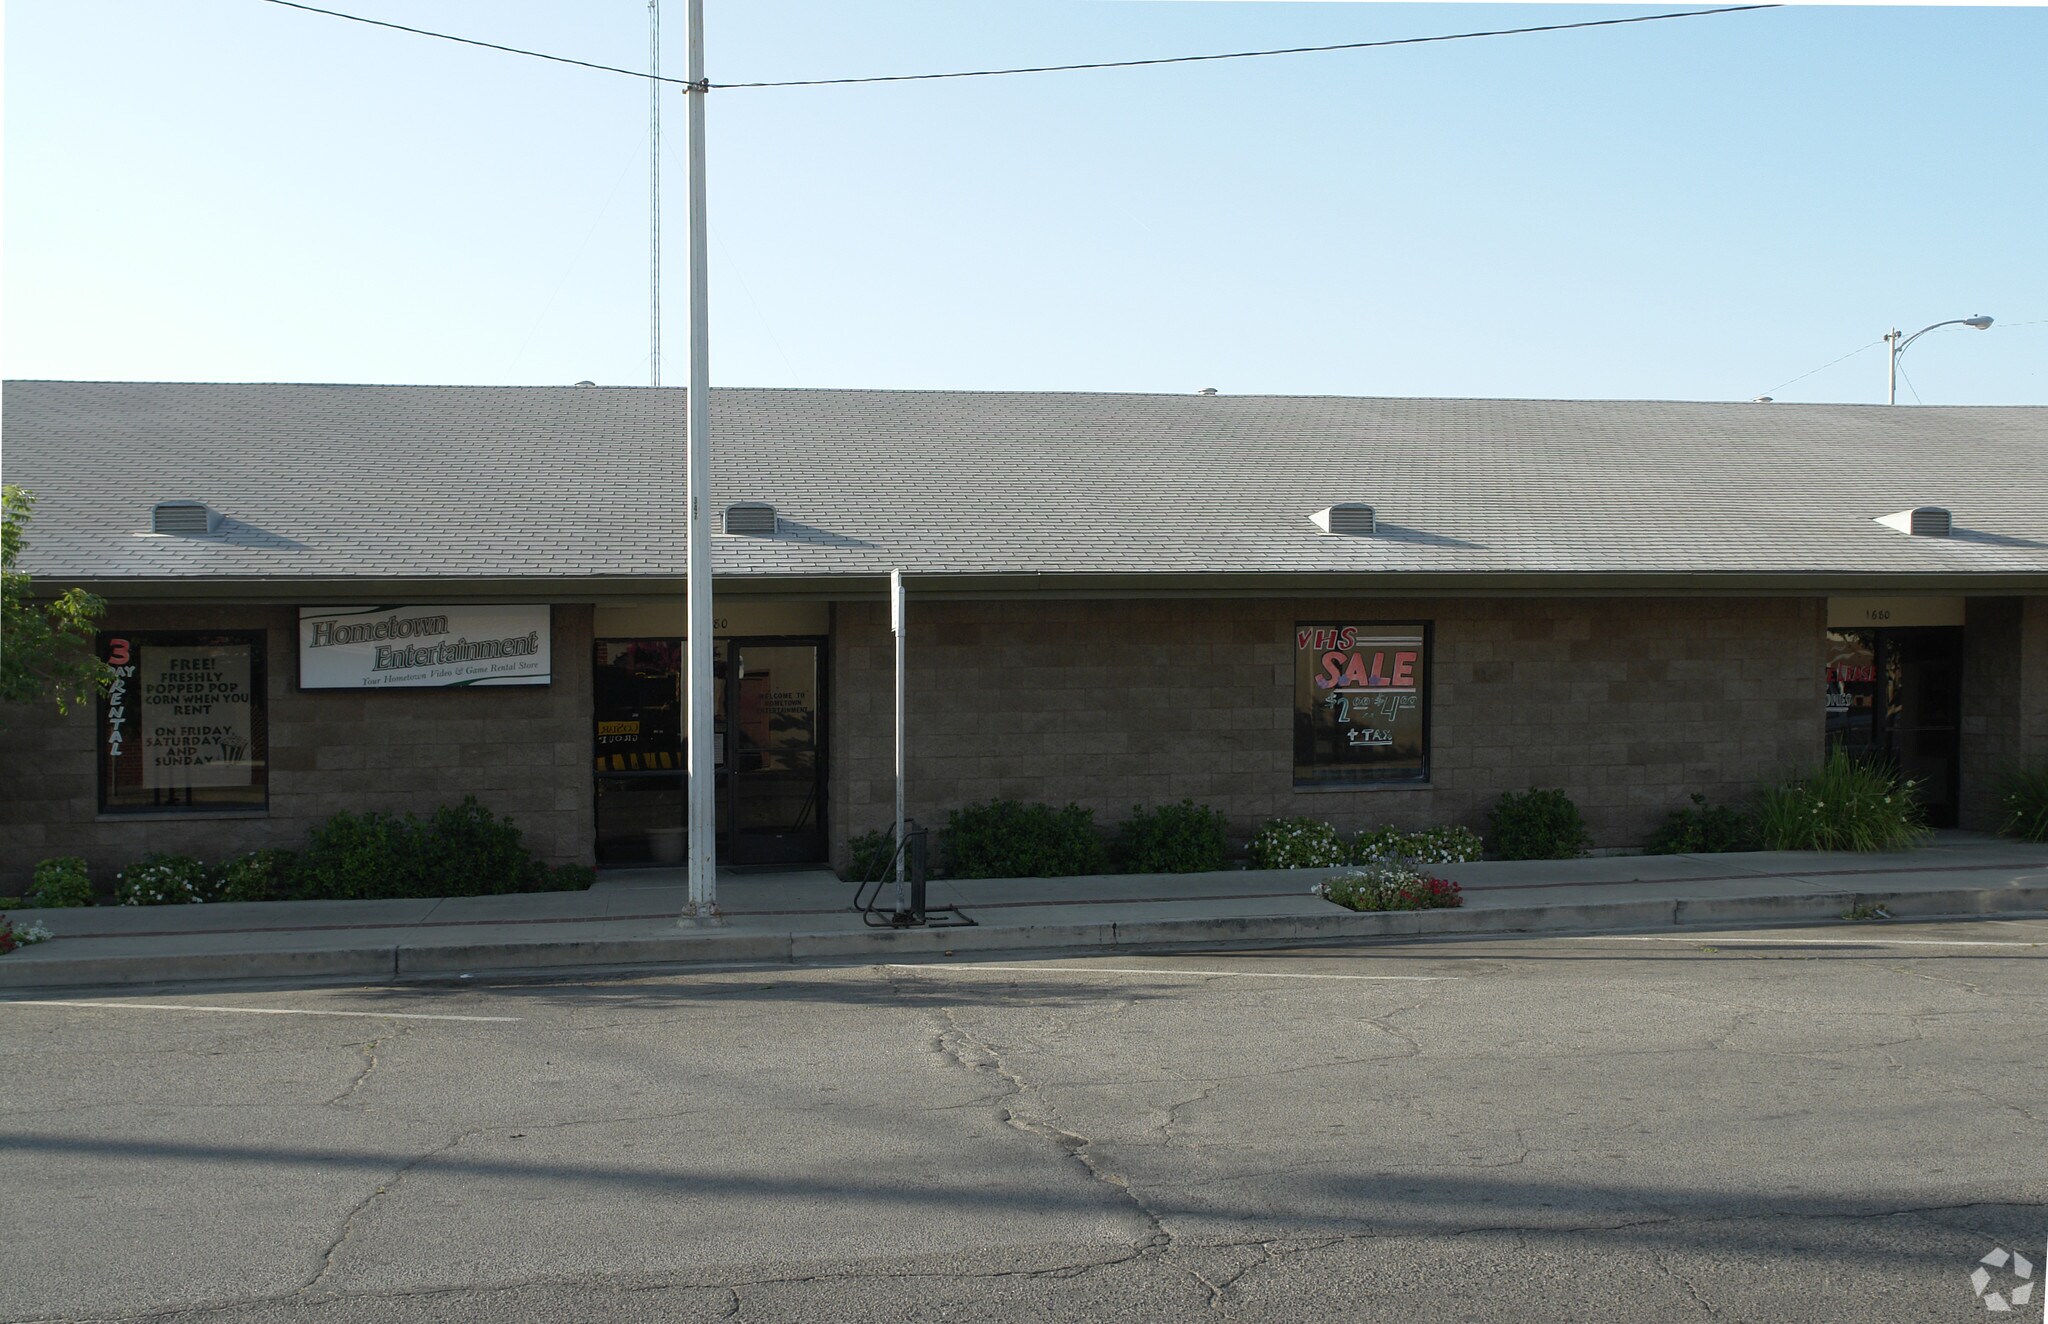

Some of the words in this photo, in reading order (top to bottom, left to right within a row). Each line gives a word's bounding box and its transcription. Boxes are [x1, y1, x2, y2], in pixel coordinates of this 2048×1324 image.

[1866, 610, 1890, 620] 1680
[309, 614, 450, 648] Hometown
[1298, 626, 1358, 650] VHS
[108, 638, 130, 665] 3
[372, 631, 538, 672] Entertainment
[170, 658, 216, 671] FREE!
[1315, 651, 1417, 689] SALE
[161, 672, 224, 683] FRESHLY
[361, 677, 380, 687] Your
[384, 673, 427, 684] Hometown
[430, 669, 453, 679] Video
[455, 667, 464, 676] &
[465, 666, 488, 675] Game
[490, 663, 516, 672] Rental
[518, 661, 539, 670] Store
[146, 683, 204, 694] POPPED
[209, 683, 239, 694] POP
[146, 695, 180, 705] CORN
[183, 694, 220, 704] WHEN
[222, 693, 249, 704] YOU
[174, 705, 213, 716] RENT
[108, 679, 126, 756] RENTAL
[155, 727, 176, 736] ON
[1361, 728, 1393, 741] TAX
[166, 747, 198, 757] AND
[155, 756, 214, 767] SUNDAY
